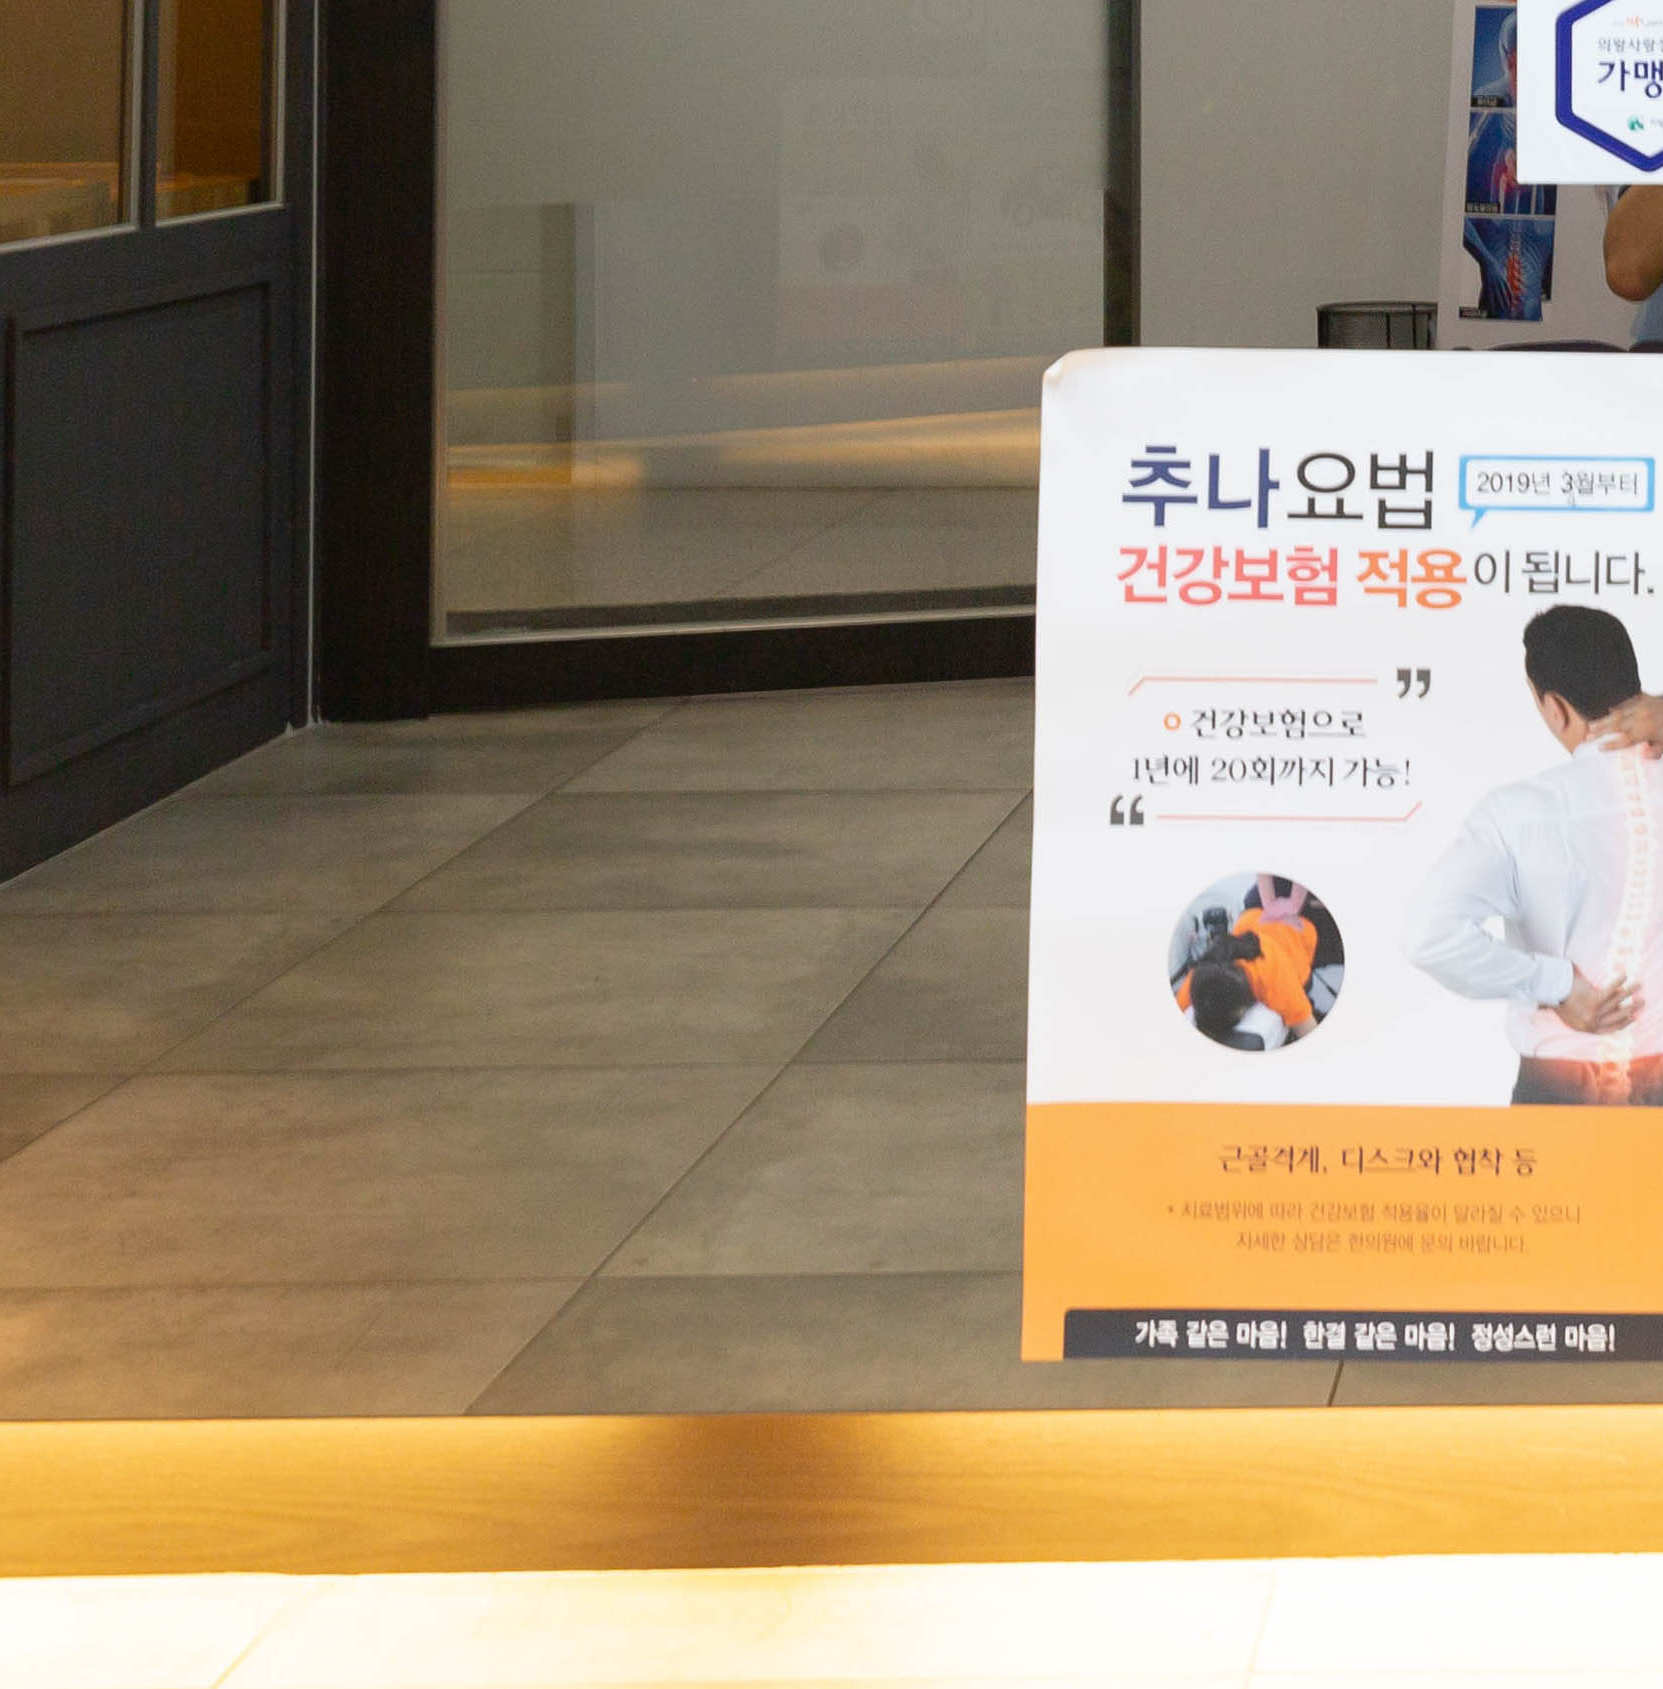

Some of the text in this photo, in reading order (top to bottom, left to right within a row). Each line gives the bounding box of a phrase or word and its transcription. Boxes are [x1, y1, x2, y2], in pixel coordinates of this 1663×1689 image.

[1122, 445, 1436, 531] 추나요법
[1476, 470, 1640, 498] 2019년 3월부터
[1116, 544, 1339, 608] 건강보험
[1190, 709, 1367, 741] 건강보험으로
[1132, 755, 1412, 789] 1년에 20회까지 가능!
[1342, 1146, 1441, 1176] 디스크와
[1453, 1147, 1503, 1177] 협착
[1512, 1147, 1537, 1177] 등
[1135, 1321, 1615, 1351] 가족 같은 마음! 한결 같은 마음! 정성스런 마음!
